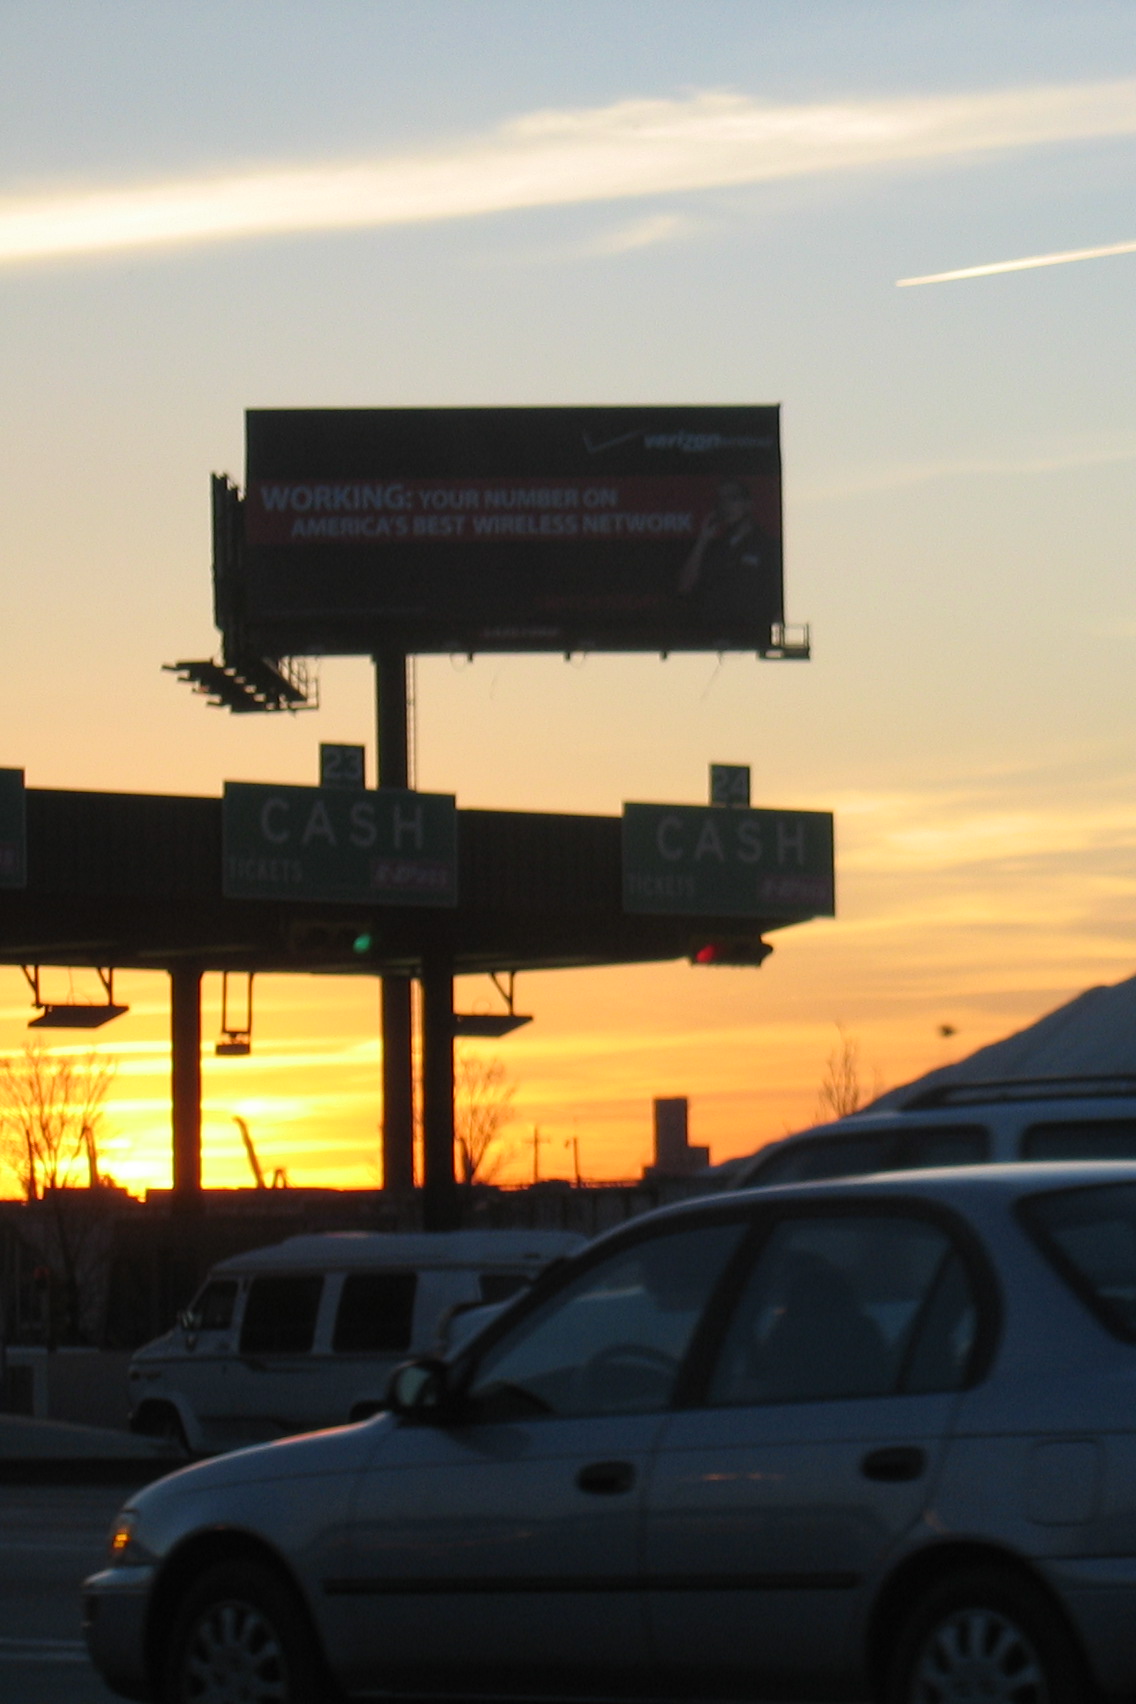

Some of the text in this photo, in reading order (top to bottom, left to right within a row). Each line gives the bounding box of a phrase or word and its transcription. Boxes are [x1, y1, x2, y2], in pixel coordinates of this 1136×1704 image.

[643, 429, 721, 452] verizon
[260, 484, 619, 511] WORKING: YOUR NUMBER ON
[291, 511, 694, 537] AMERICA'S BEST WIRELESS NETWORK
[324, 747, 362, 779] 23
[263, 797, 423, 849] CASH
[656, 814, 807, 867] CASH
[227, 855, 303, 884] TICKETS
